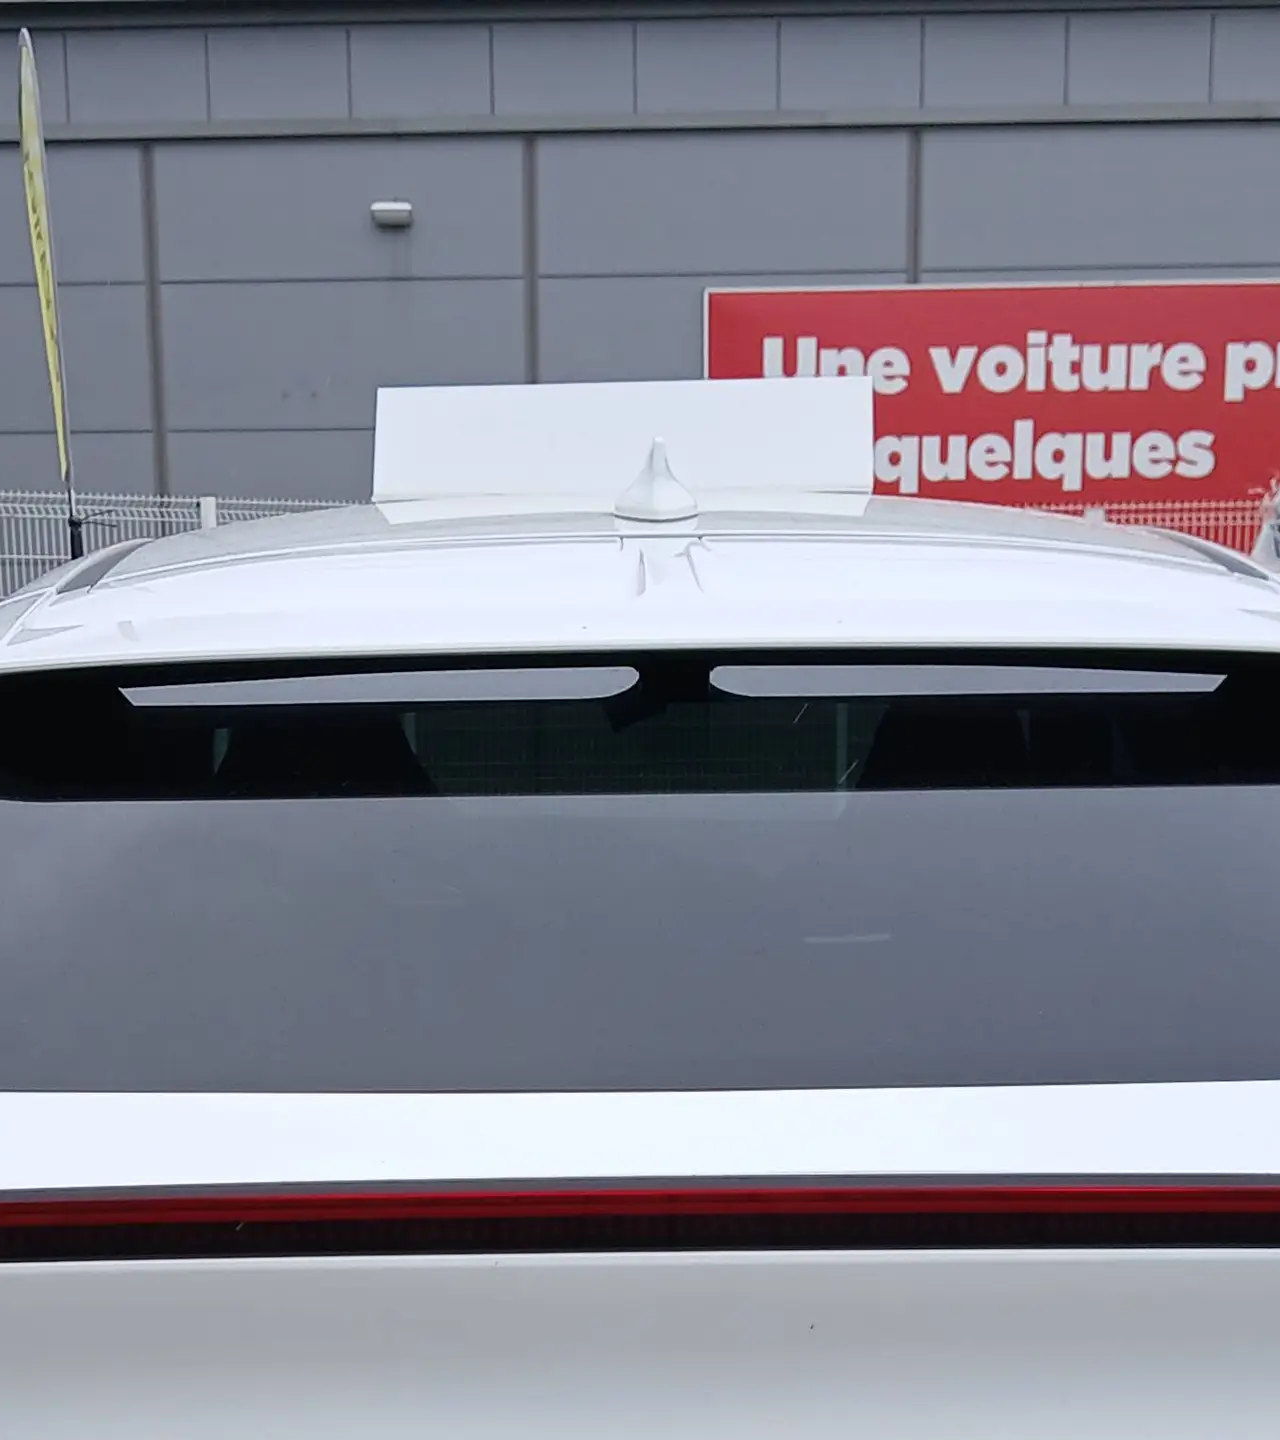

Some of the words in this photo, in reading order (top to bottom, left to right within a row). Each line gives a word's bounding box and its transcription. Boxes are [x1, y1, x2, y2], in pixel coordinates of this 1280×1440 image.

[763, 336, 911, 395] Une
[928, 329, 1207, 394] voiture
[873, 418, 1216, 494] quelques
